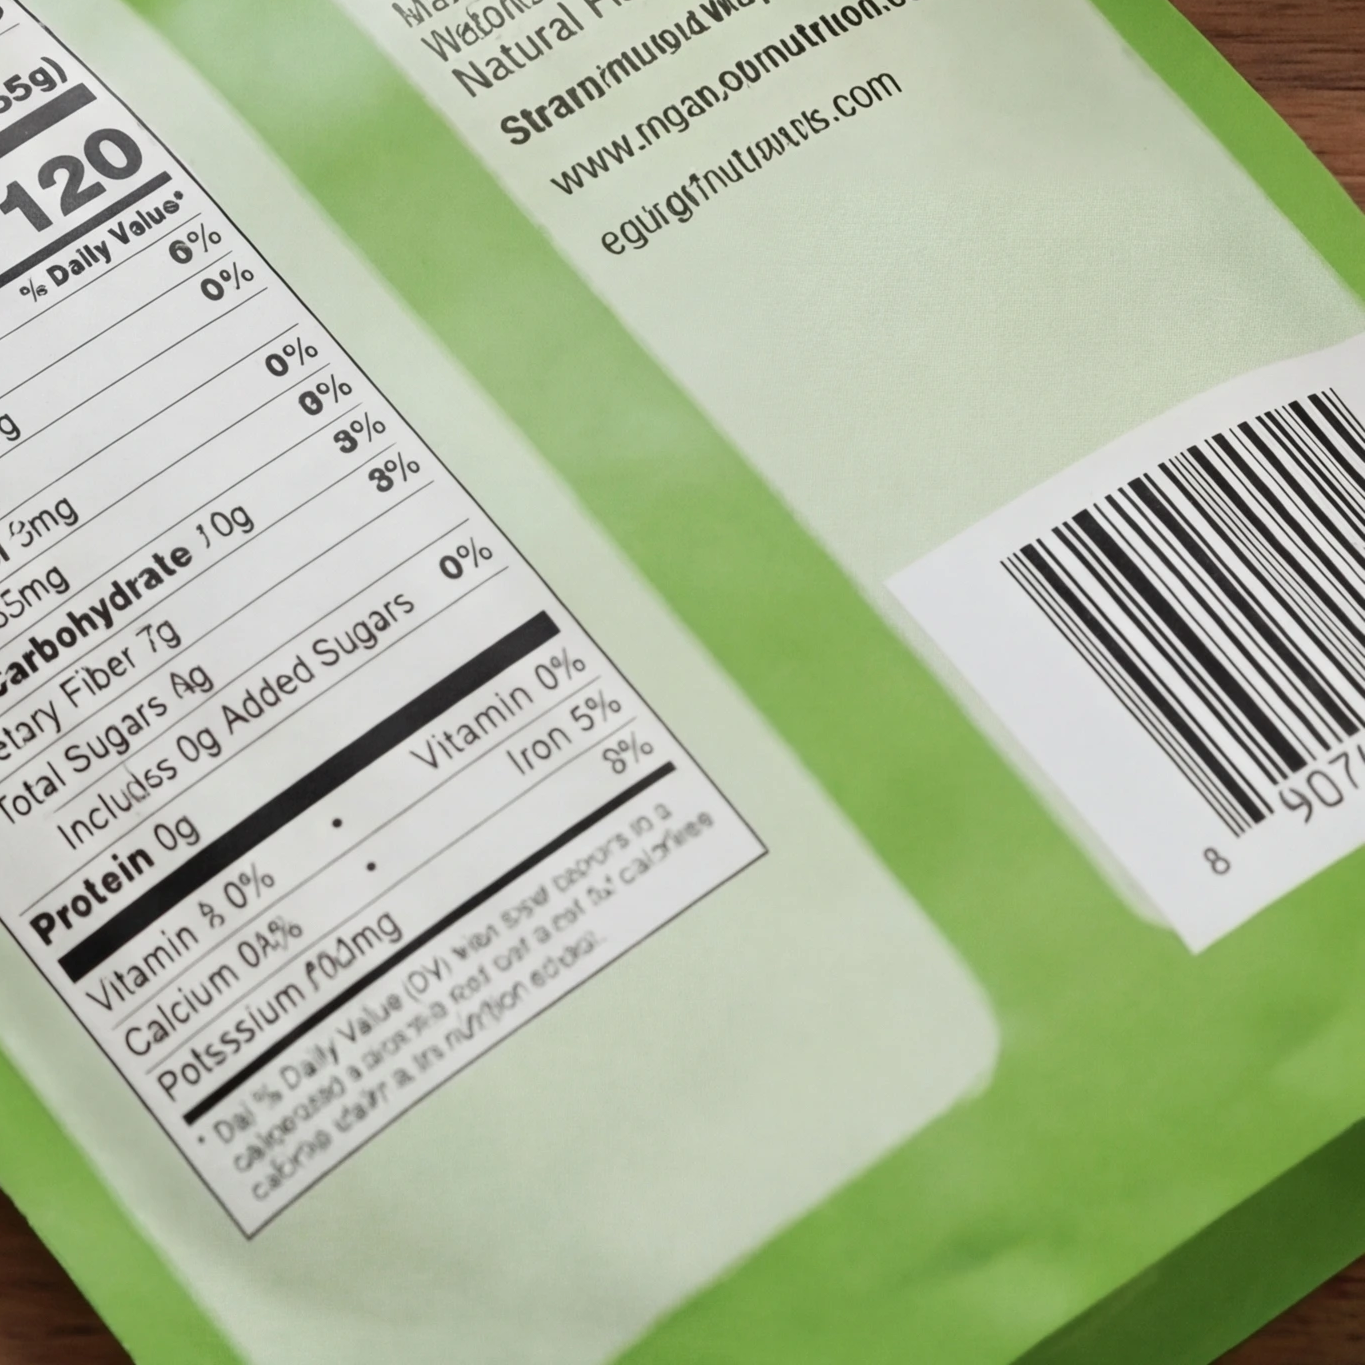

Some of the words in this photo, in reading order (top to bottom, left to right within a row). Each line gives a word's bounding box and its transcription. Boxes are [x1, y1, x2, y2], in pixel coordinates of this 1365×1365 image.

[450, 1, 585, 99] Natural
[45, 239, 113, 288] Daily
[199, 261, 255, 302] 0%
[264, 336, 319, 378] 0%
[220, 654, 316, 736] Added
[311, 593, 415, 667] Sugars
[438, 536, 493, 581] 0%
[58, 646, 136, 709] Fiber
[63, 695, 168, 774] Sugars
[84, 926, 200, 1012] Vitamin
[409, 686, 534, 770] Vitamin
[534, 654, 586, 691] 0%
[1202, 846, 1232, 876] 8
[28, 847, 156, 947] Protein
[124, 964, 240, 1057] Calcium
[506, 727, 572, 775] Iron
[569, 697, 622, 732] 5%
